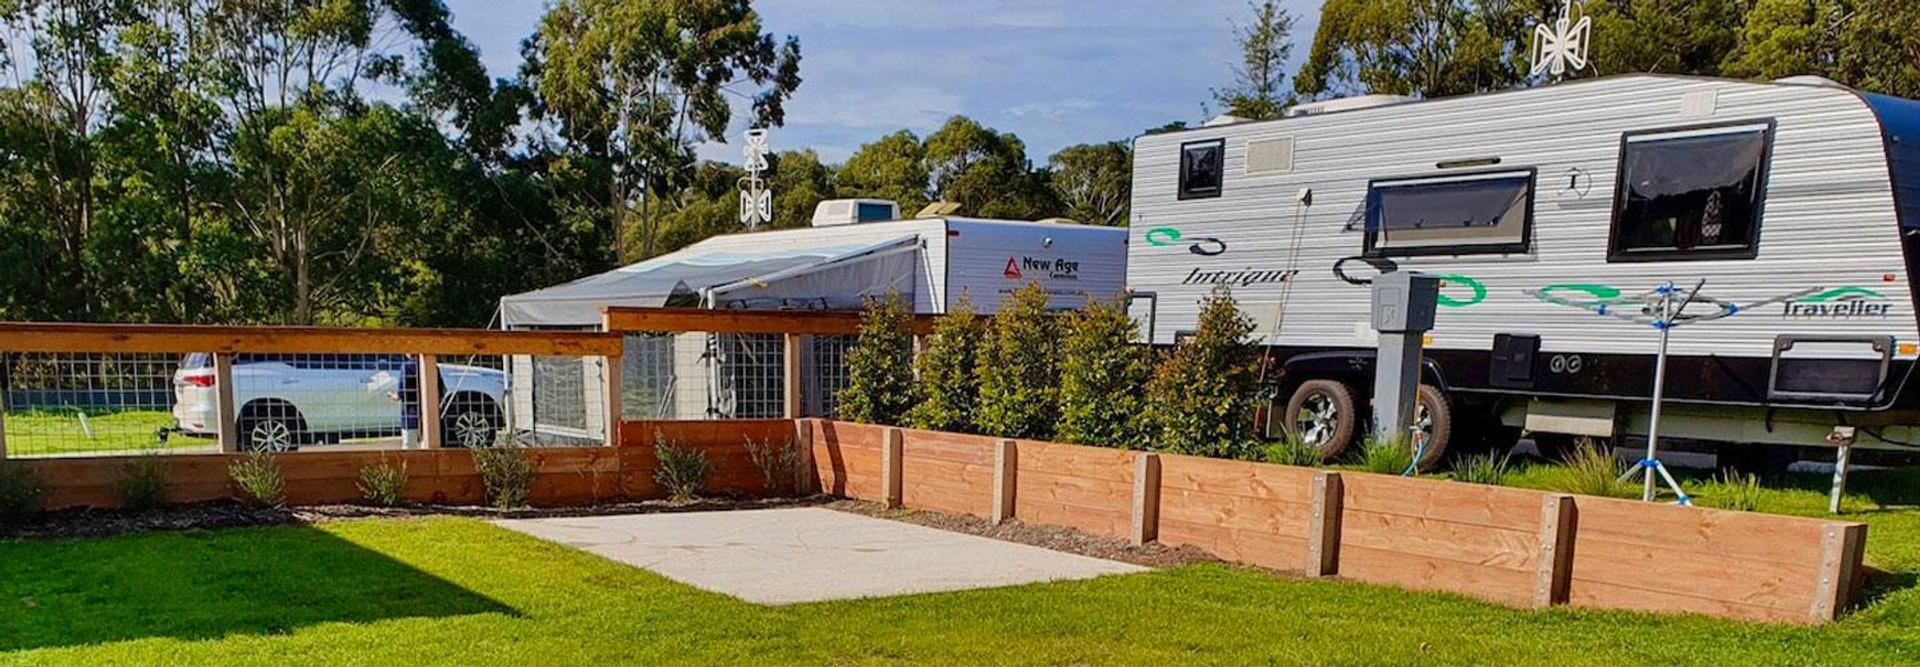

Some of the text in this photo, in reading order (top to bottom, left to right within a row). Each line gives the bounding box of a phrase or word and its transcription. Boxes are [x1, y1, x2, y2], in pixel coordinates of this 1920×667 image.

[1023, 256, 1079, 274] New Age
[1182, 266, 1299, 287] Intrigue
[1782, 299, 1893, 317] Traveller
